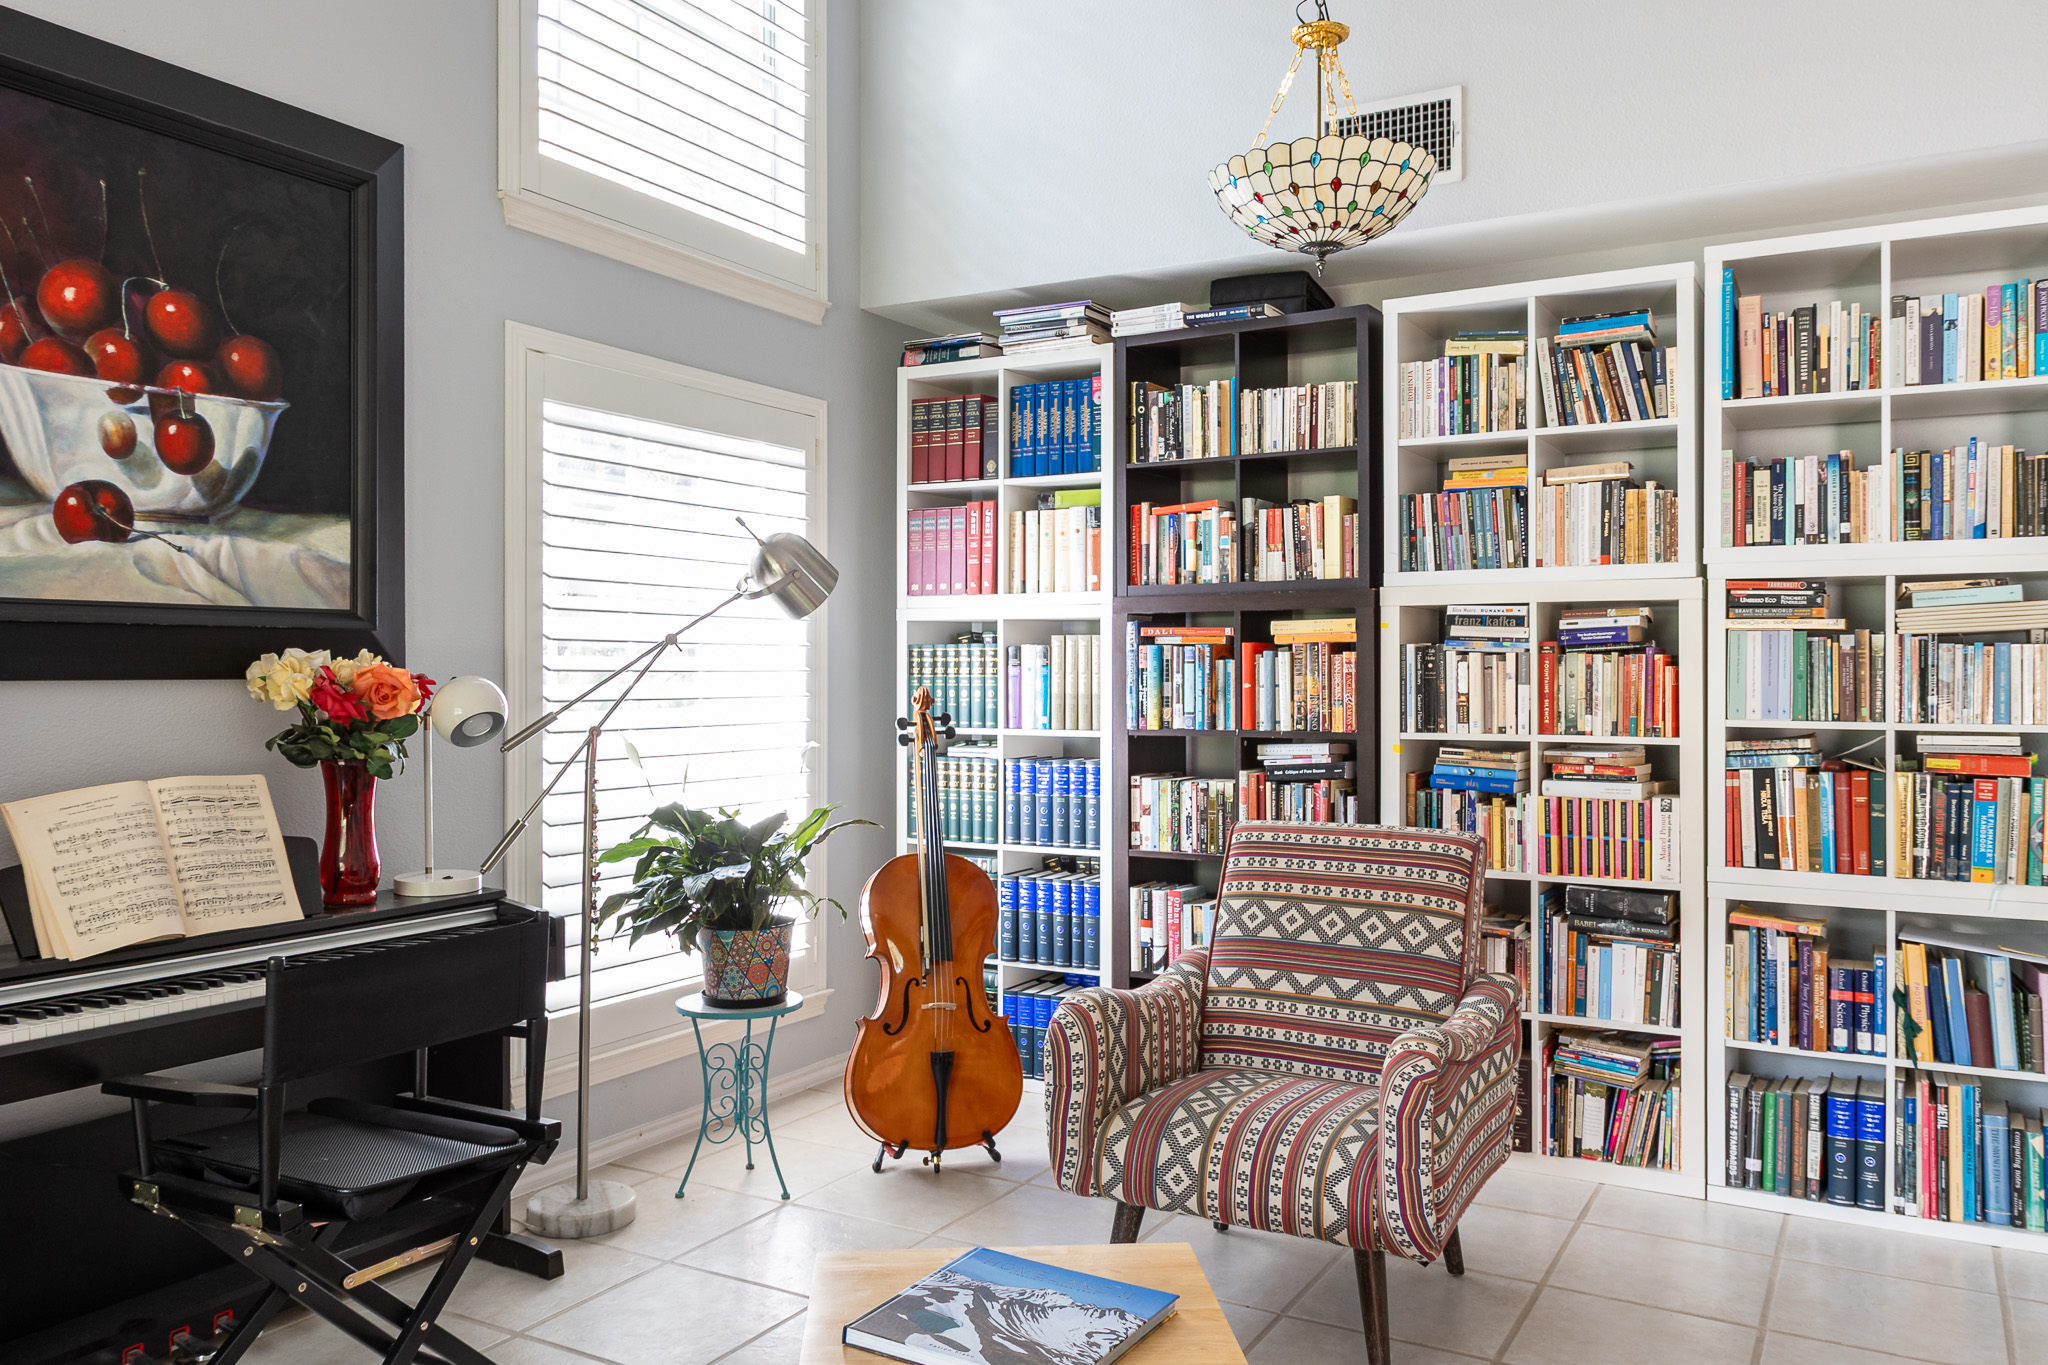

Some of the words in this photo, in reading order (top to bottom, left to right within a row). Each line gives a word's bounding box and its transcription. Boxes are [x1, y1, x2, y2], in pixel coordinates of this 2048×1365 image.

[1989, 306, 1999, 323] Help
[1800, 331, 1808, 348] KATE
[1800, 349, 1808, 381] ATKINSON
[1933, 465, 1941, 508] CHOCOLAT
[1454, 616, 1481, 626] franz
[1486, 616, 1516, 627] kafka
[1295, 645, 1304, 656] DAN
[1310, 695, 1319, 730] INFERNO
[2034, 783, 2042, 796] REEL
[1936, 796, 1944, 810] THE
[1962, 799, 1970, 818] Structural
[2034, 797, 2042, 814] MUSIC
[1936, 812, 1944, 837] HISTORY
[1979, 815, 1987, 852] HANDBOOK
[1986, 819, 1994, 863] FILMMAKER'S
[1936, 847, 1944, 863] JAZZ
[1574, 919, 1597, 928] BABEL
[1803, 946, 1811, 976] Schoenberg
[1769, 961, 1777, 987] Music
[1802, 982, 1811, 1002] Theory
[1914, 981, 1922, 1006] PHOTO
[1802, 1009, 1811, 1035] Harmony
[1836, 1002, 1846, 1030] Scienc
[1860, 1004, 1870, 1032] Physics
[1916, 1008, 1924, 1029] ALBU
[1730, 1092, 1739, 1110] THE
[1811, 1095, 1820, 1119] SCORING
[1730, 1110, 1739, 1129] JAZZ
[1811, 1120, 1820, 1131] THE
[1937, 1104, 1949, 1129] METAL
[1992, 1129, 2000, 1144] THE
[1729, 1131, 1738, 1176] STANDARDS
[2013, 1131, 2023, 1169] comparing
[2015, 1170, 2024, 1189] notes
[983, 1258, 1113, 1295] HOMELAND
